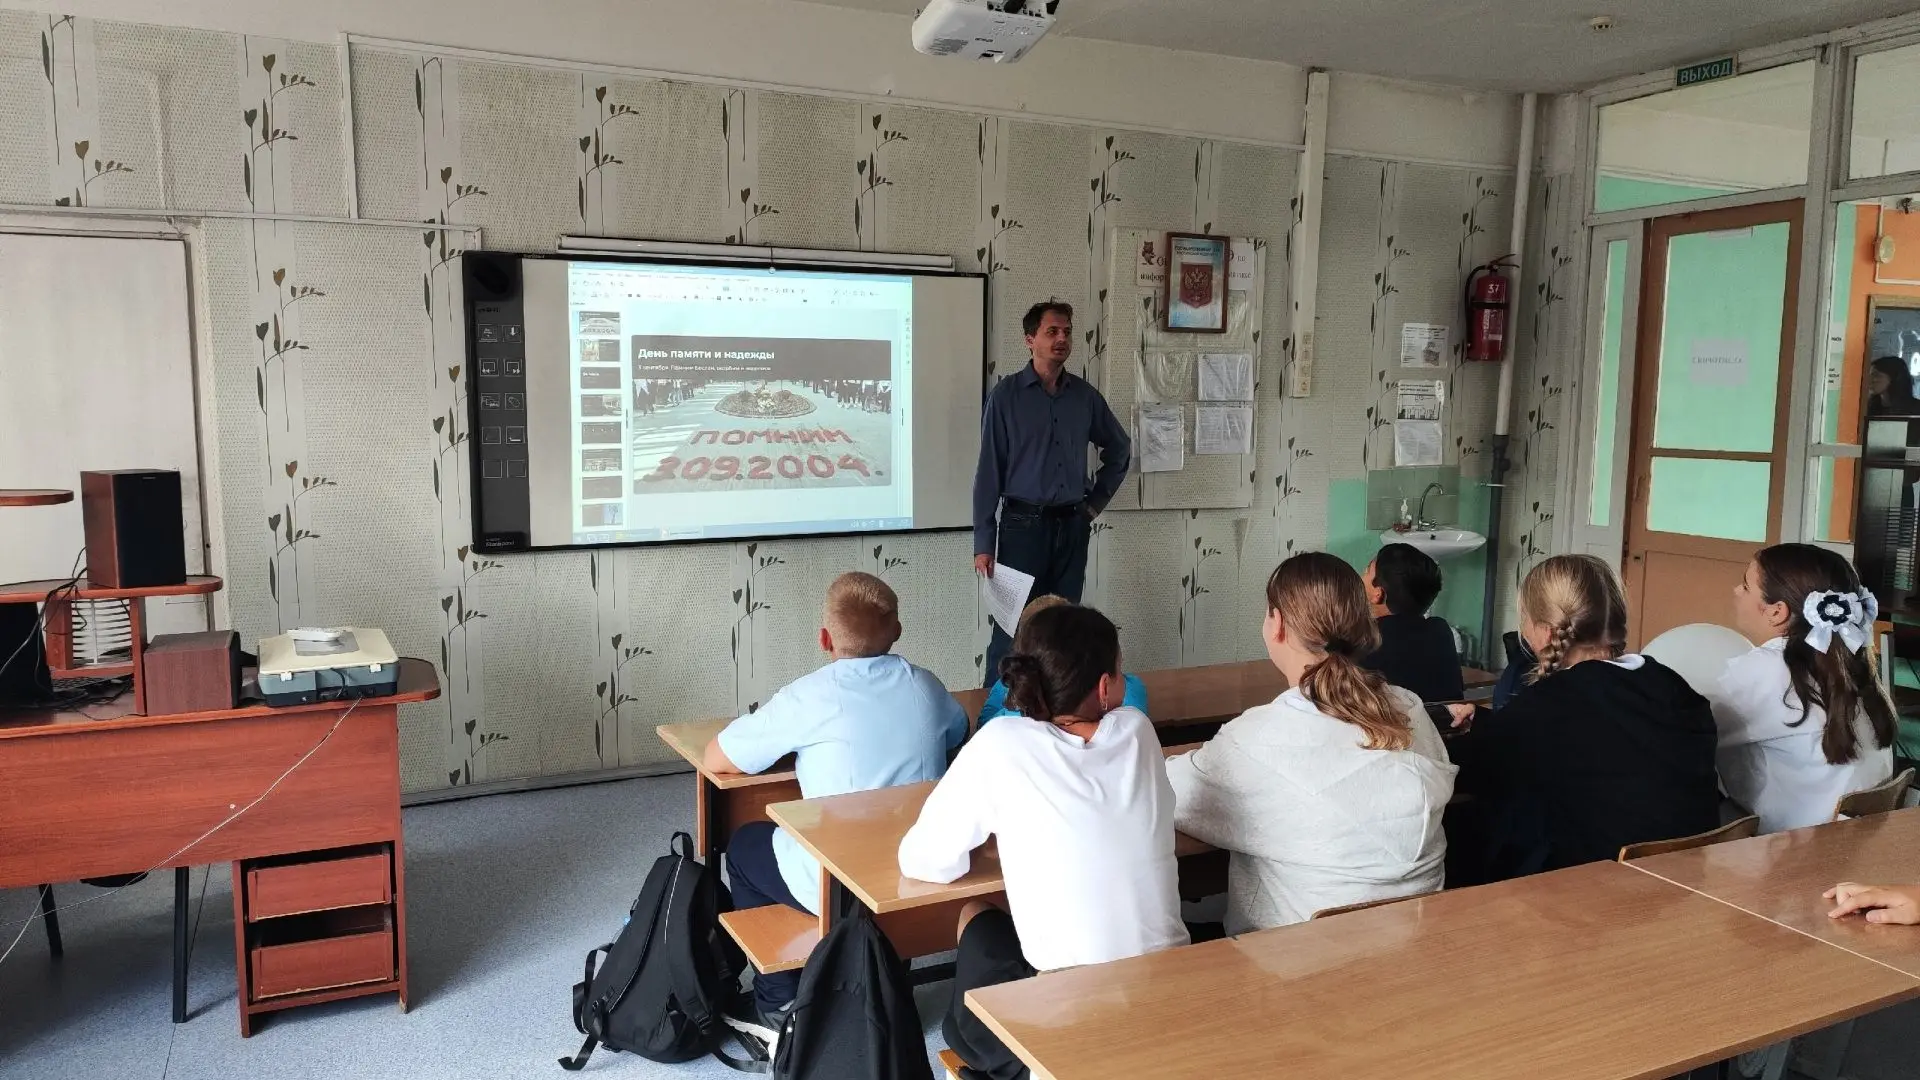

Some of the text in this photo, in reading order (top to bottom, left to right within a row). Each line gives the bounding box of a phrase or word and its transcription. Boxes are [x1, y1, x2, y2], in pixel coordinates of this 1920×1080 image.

[1680, 62, 1731, 83] ВЫХОД
[1488, 284, 1500, 294] 37
[638, 348, 775, 360] День памяти и надежды
[690, 429, 856, 445] ПОМНИМ
